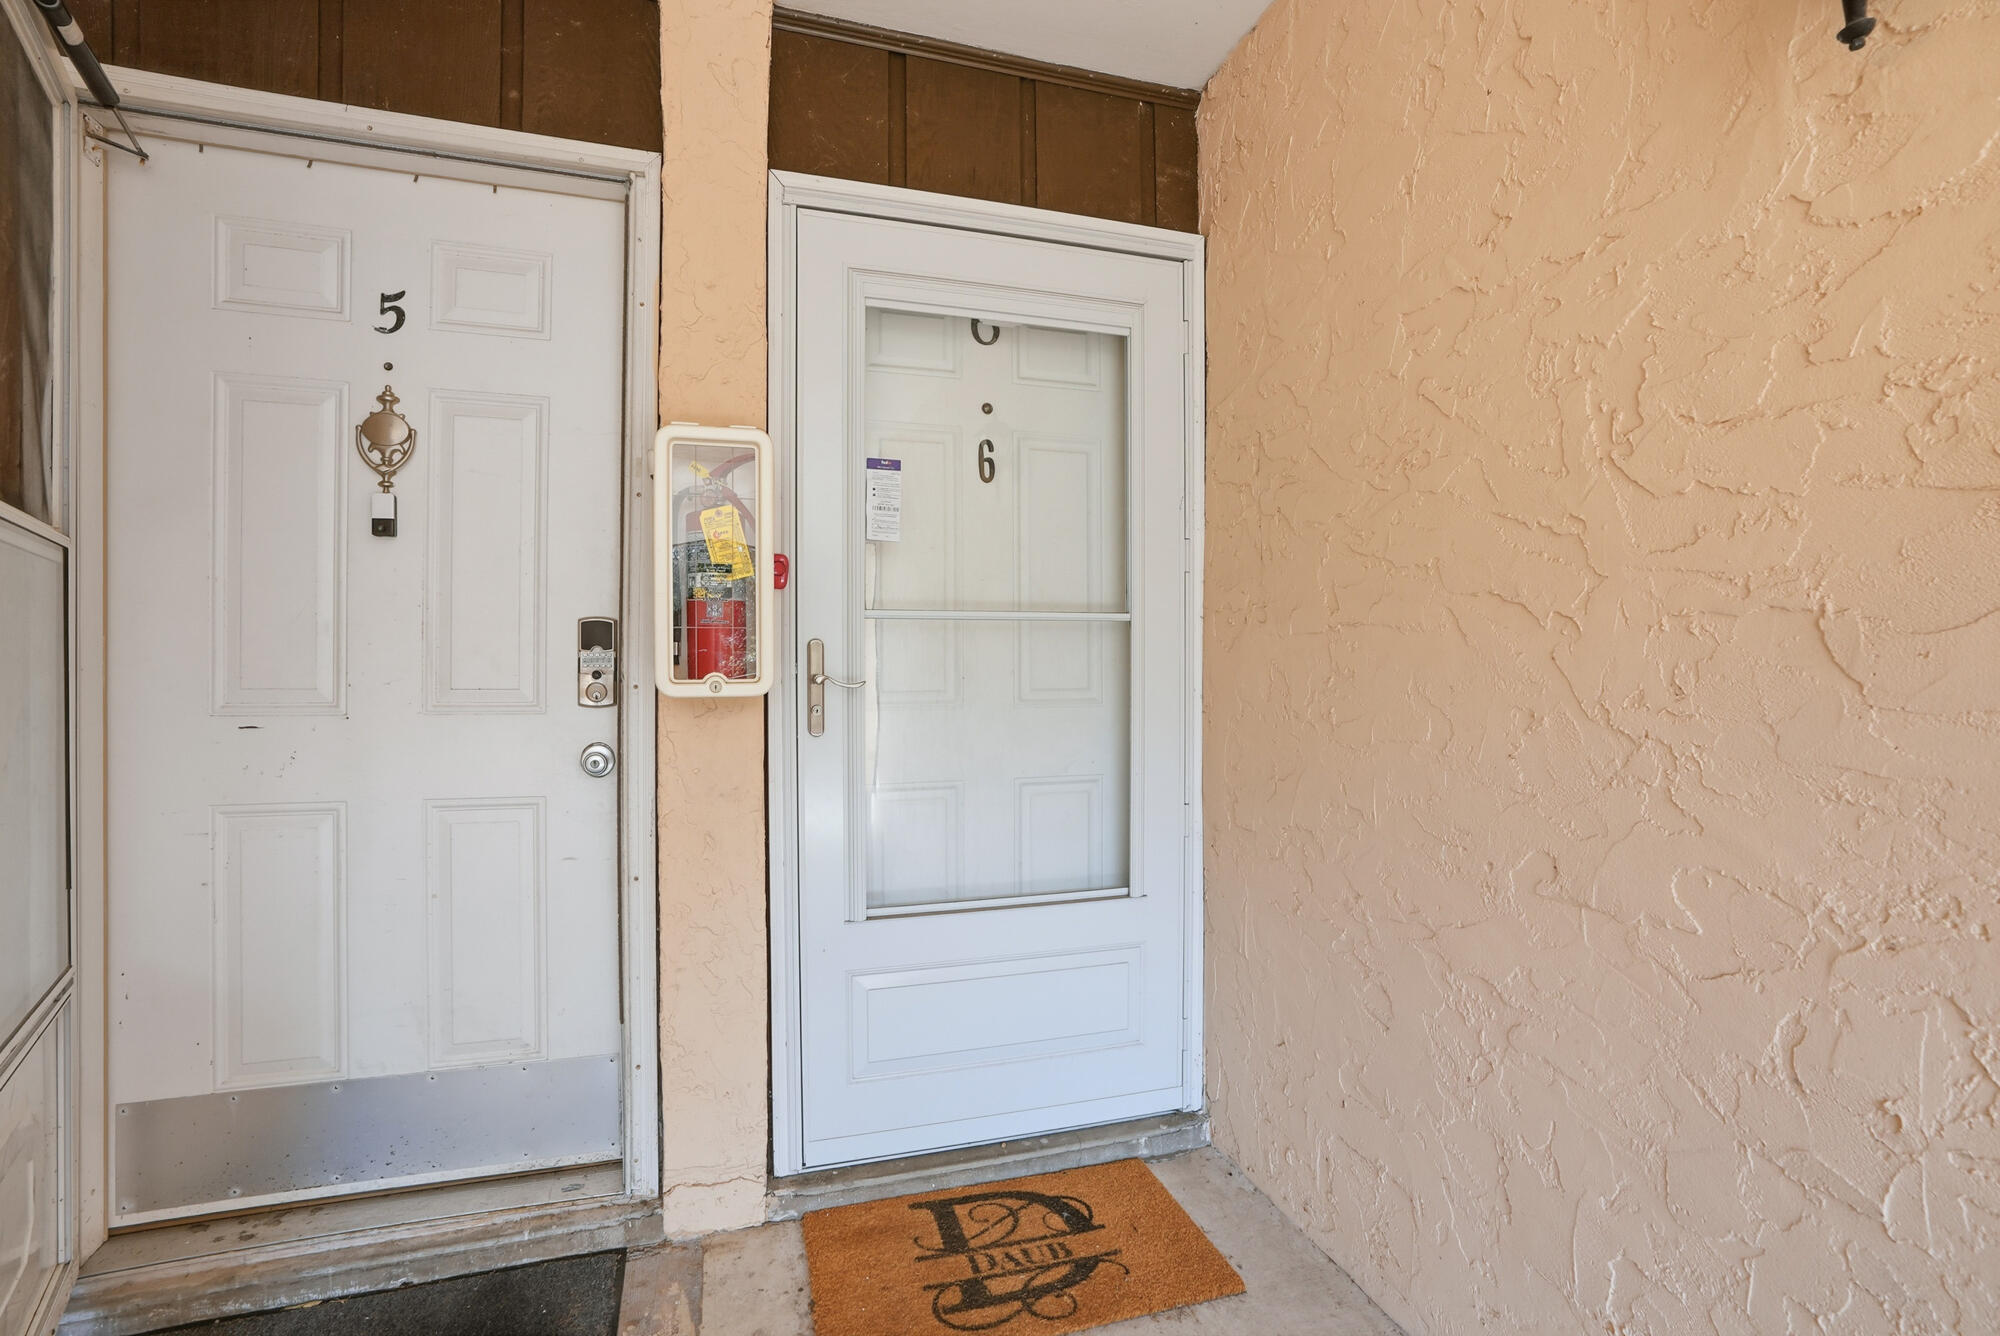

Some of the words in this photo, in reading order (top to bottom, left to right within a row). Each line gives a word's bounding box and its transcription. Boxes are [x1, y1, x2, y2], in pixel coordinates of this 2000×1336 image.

[374, 290, 406, 334] 5
[978, 439, 996, 484] 6
[964, 1242, 1074, 1275] DAUB
